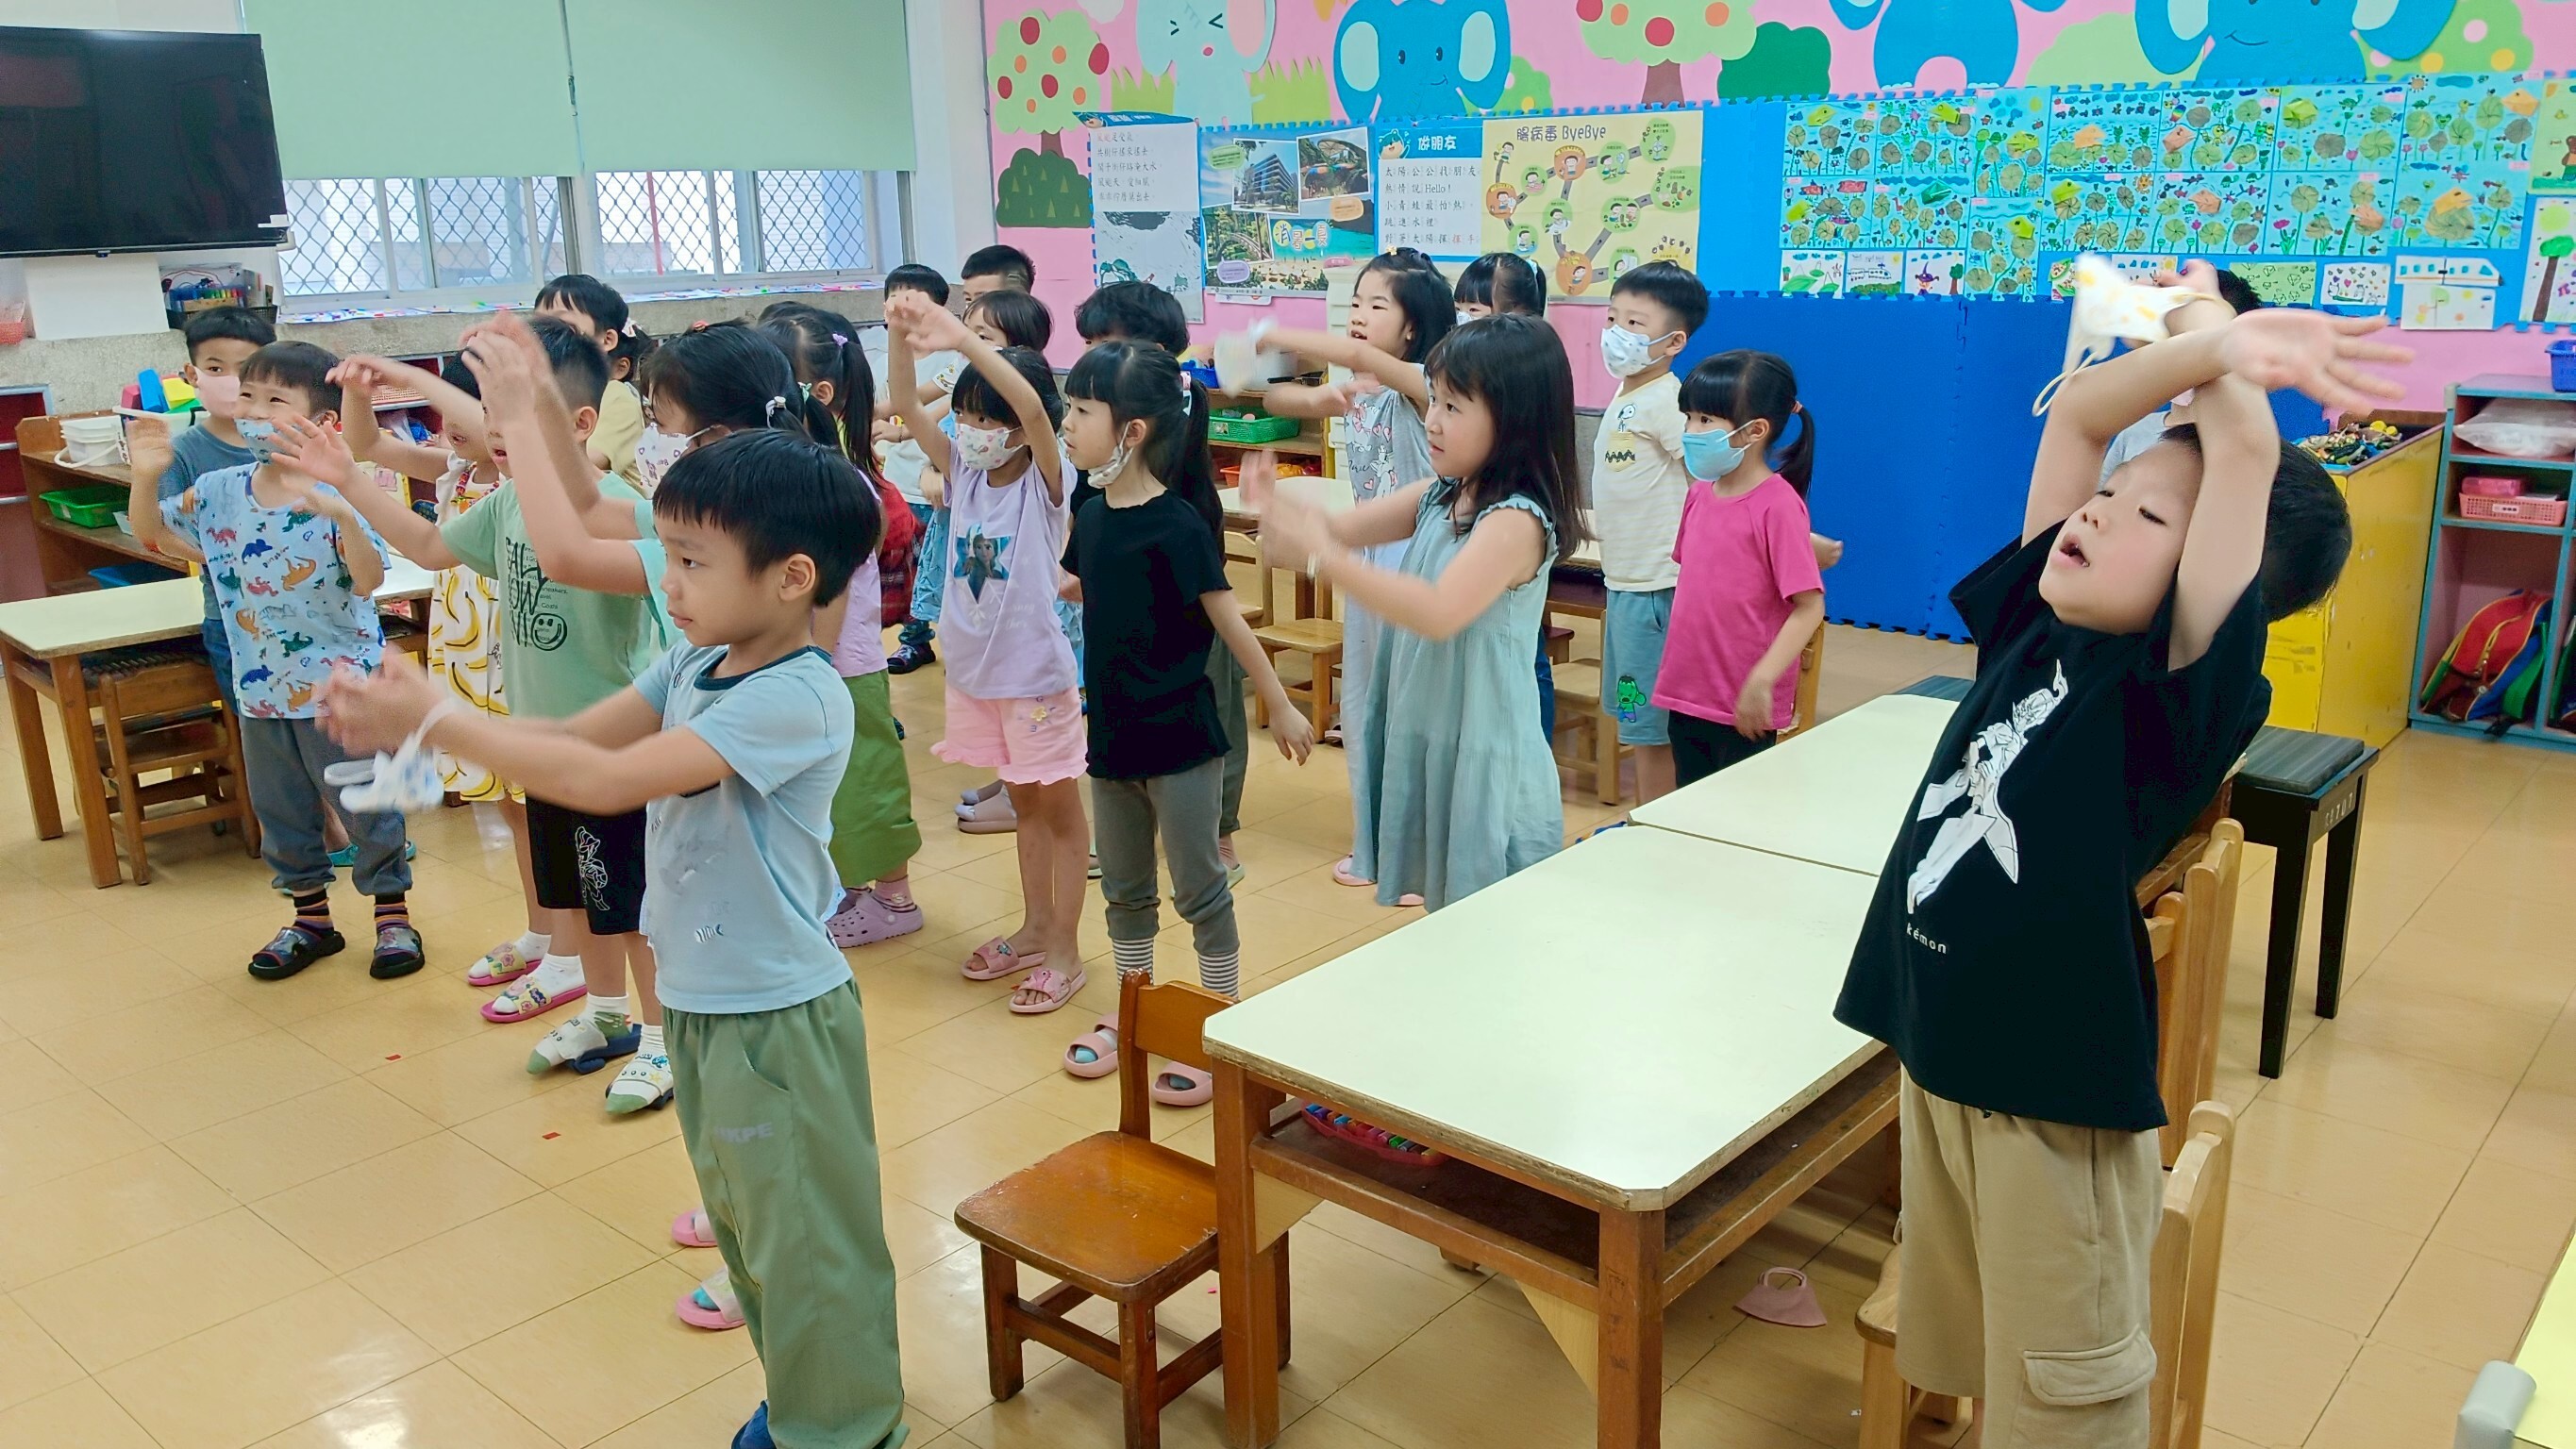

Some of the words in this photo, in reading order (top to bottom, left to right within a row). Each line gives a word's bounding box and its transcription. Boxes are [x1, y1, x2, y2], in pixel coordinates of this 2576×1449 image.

[1516, 125, 1558, 142] 腸病毒
[1562, 124, 1607, 141] ByeBye
[1418, 135, 1457, 151] 做朋友
